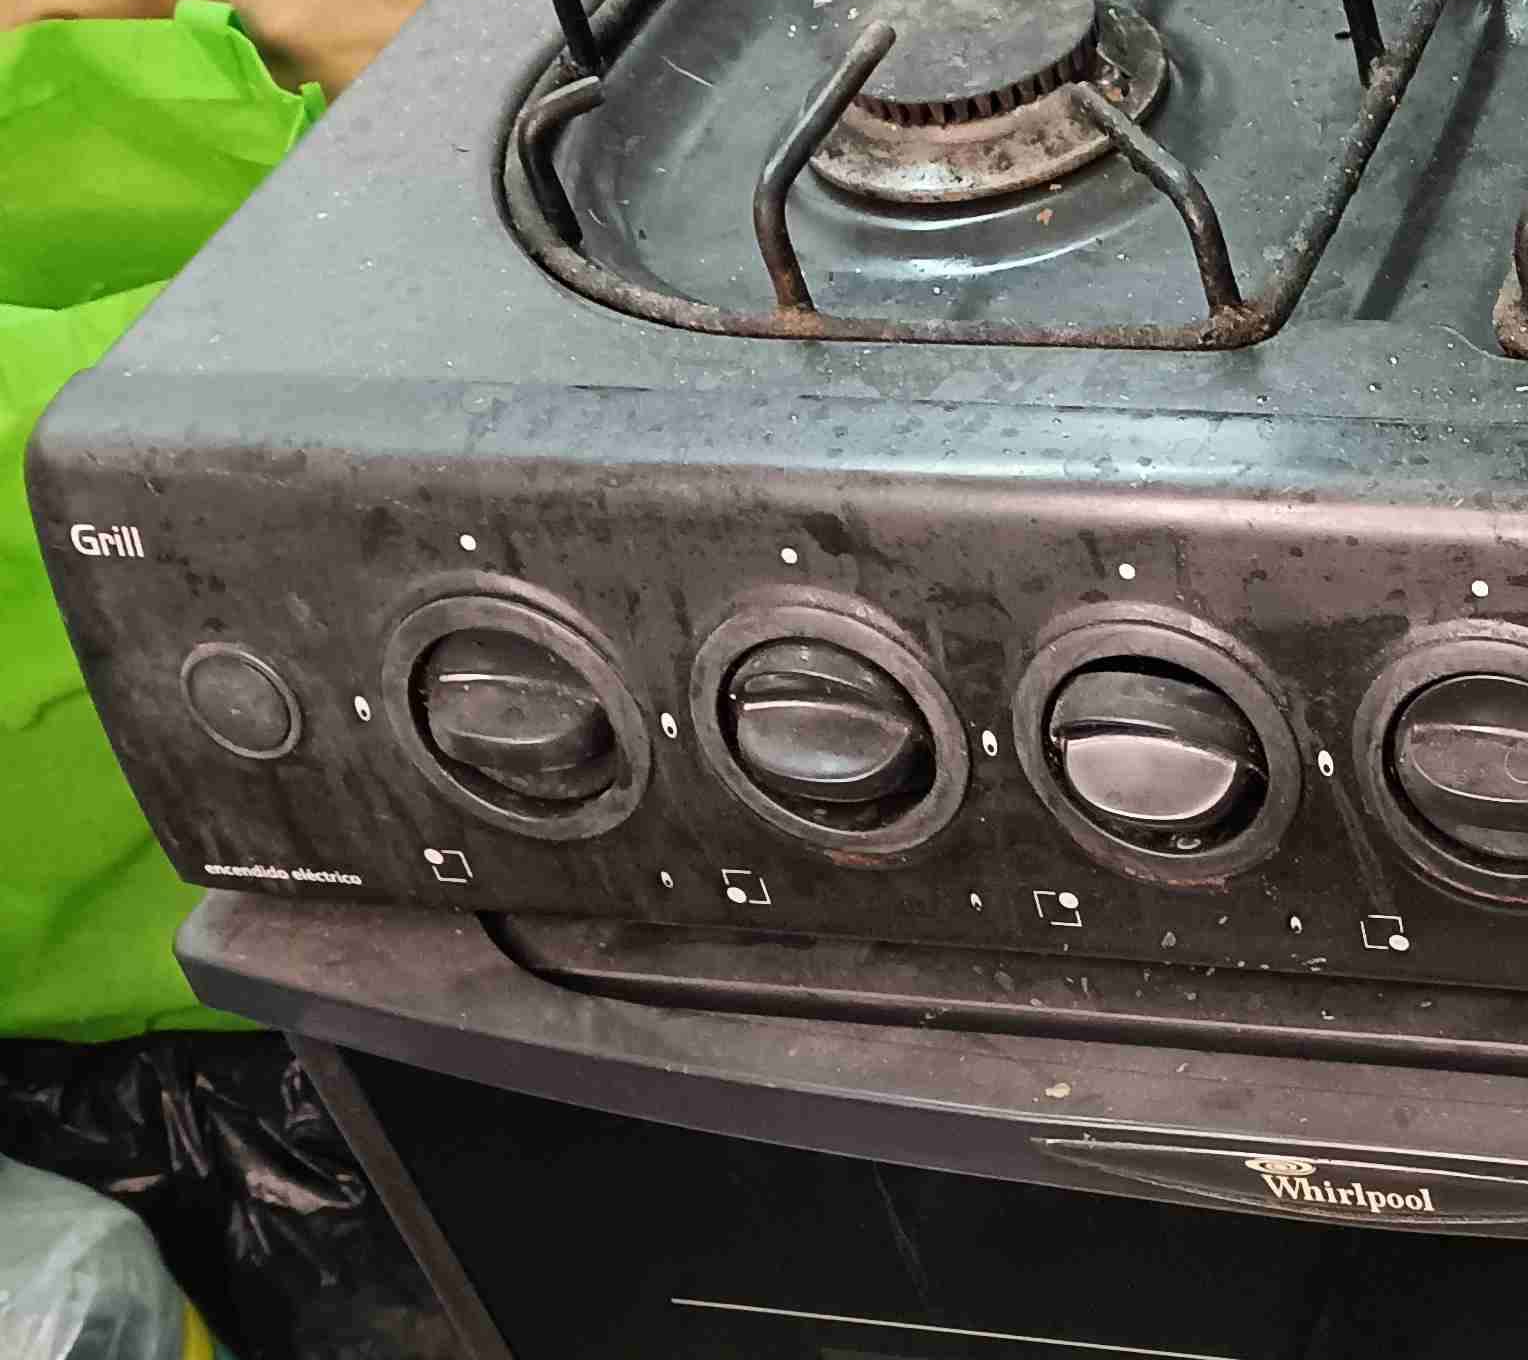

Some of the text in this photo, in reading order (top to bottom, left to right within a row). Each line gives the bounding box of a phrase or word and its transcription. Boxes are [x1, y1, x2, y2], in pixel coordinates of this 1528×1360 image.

[70, 523, 145, 558] Grill
[204, 864, 290, 880] encendido
[1262, 1173, 1436, 1214] Whirlpool
